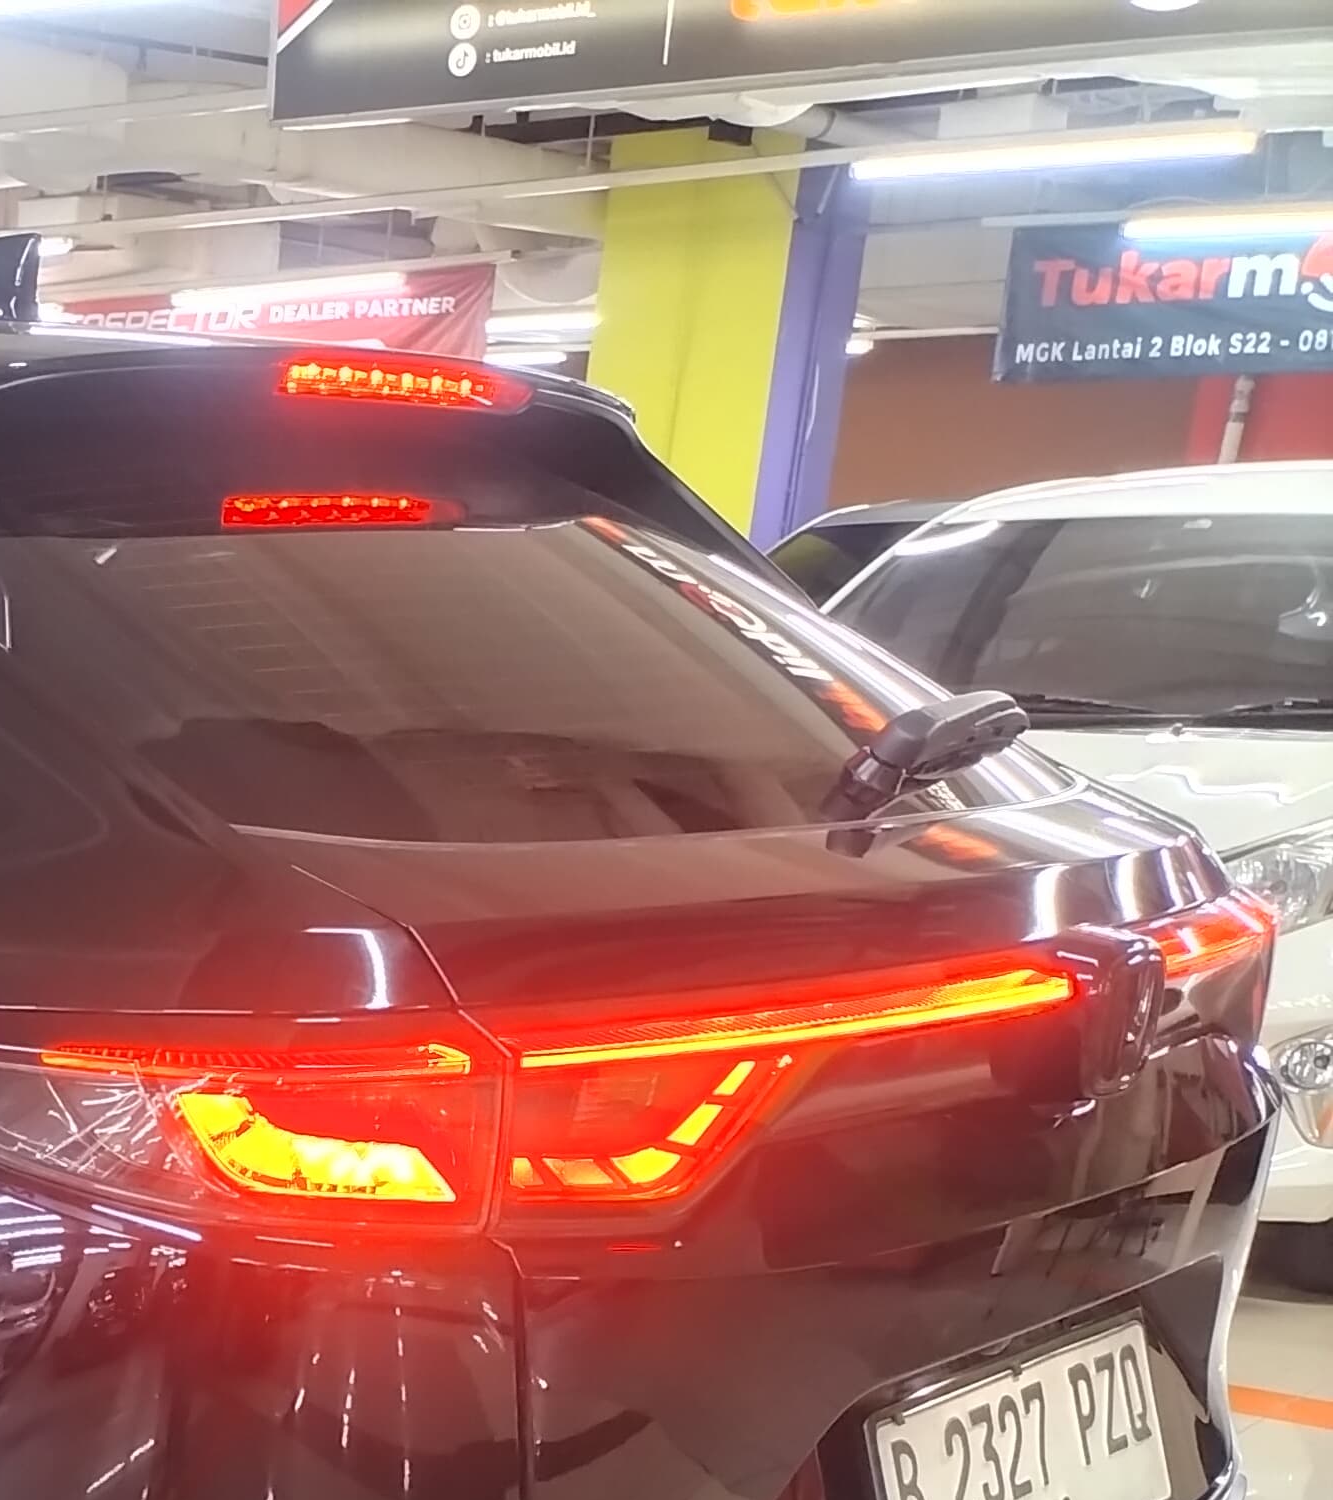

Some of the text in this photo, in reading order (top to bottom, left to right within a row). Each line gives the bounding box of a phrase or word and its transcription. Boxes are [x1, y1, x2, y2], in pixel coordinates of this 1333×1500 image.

[493, 40, 576, 63] tukarmobil.id
[269, 301, 350, 323] DEALER
[354, 296, 455, 319] PARTNER
[1015, 341, 1066, 364] MGK
[1072, 336, 1142, 361] Lantai
[1148, 336, 1163, 358] 2
[1170, 333, 1222, 357] Blok
[1229, 331, 1271, 354] S22
[1067, 1343, 1153, 1466] PZQ
